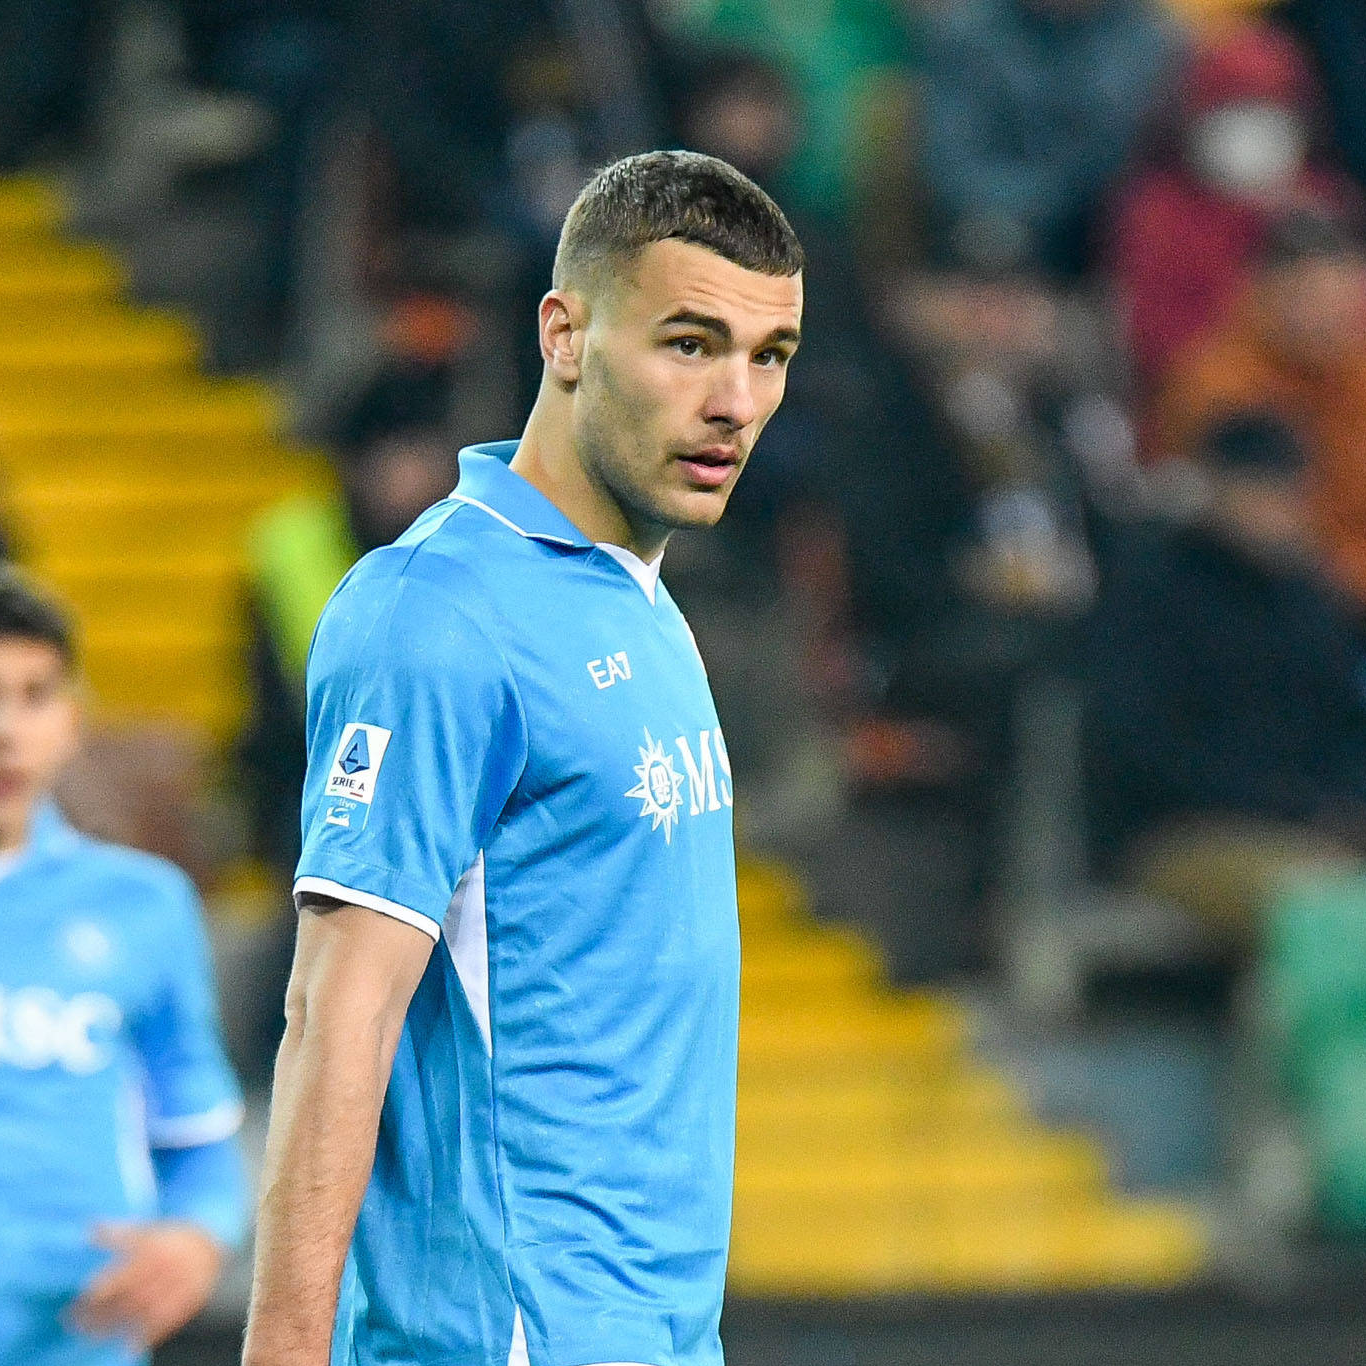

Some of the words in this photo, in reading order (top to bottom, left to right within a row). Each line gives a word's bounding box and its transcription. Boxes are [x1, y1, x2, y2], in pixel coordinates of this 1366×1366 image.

[586, 651, 633, 690] EA7
[332, 776, 357, 789] SERIE
[358, 782, 365, 792] A
